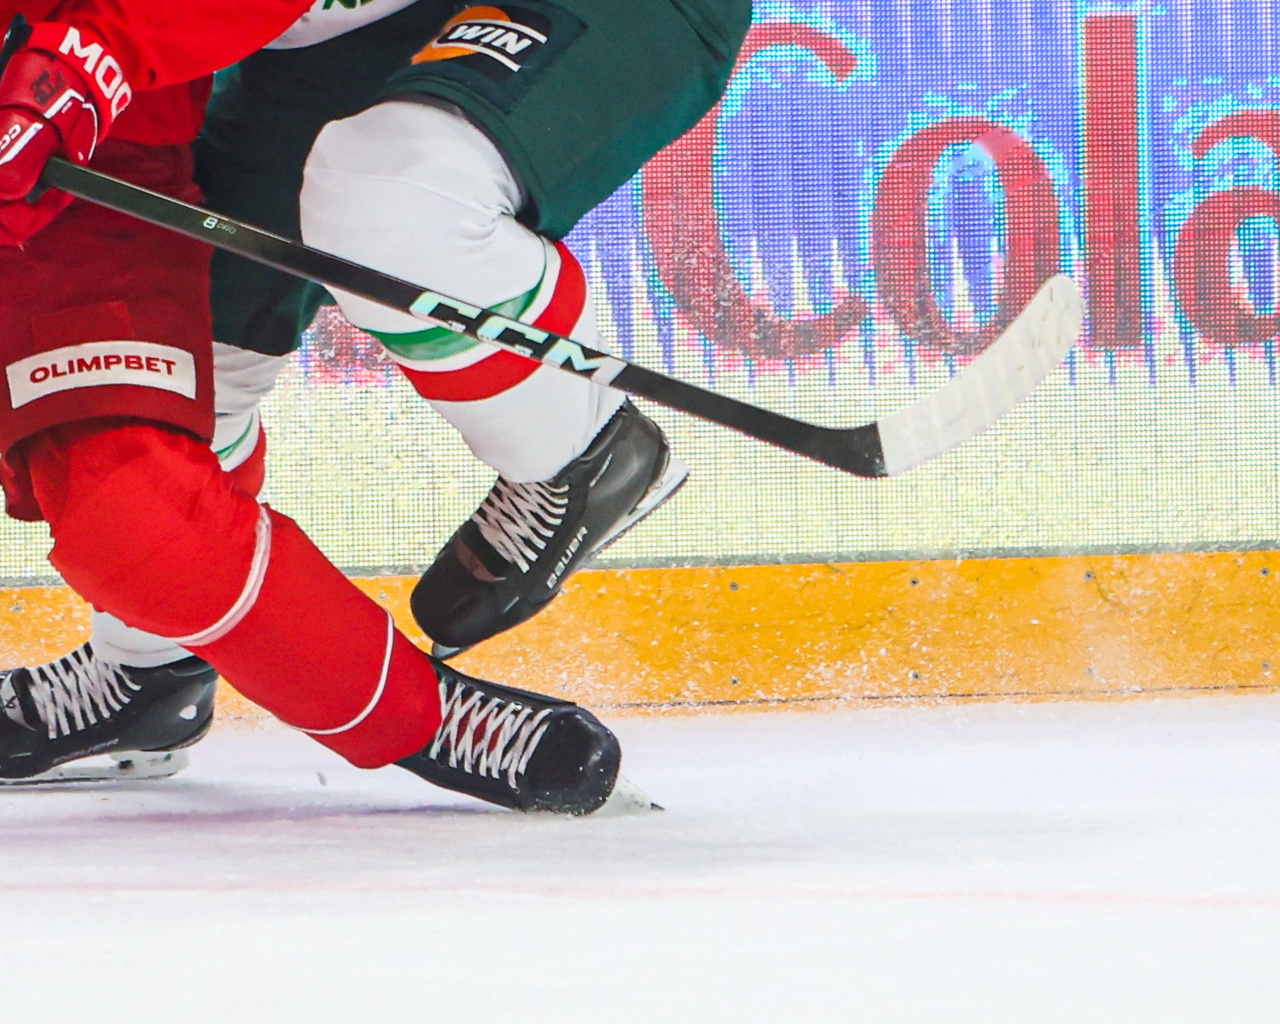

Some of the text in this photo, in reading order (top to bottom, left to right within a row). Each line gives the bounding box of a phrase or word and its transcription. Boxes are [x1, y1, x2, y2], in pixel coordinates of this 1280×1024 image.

[447, 24, 533, 56] WIN
[408, 290, 628, 386] CCM
[29, 354, 177, 384] OLIMPBET
